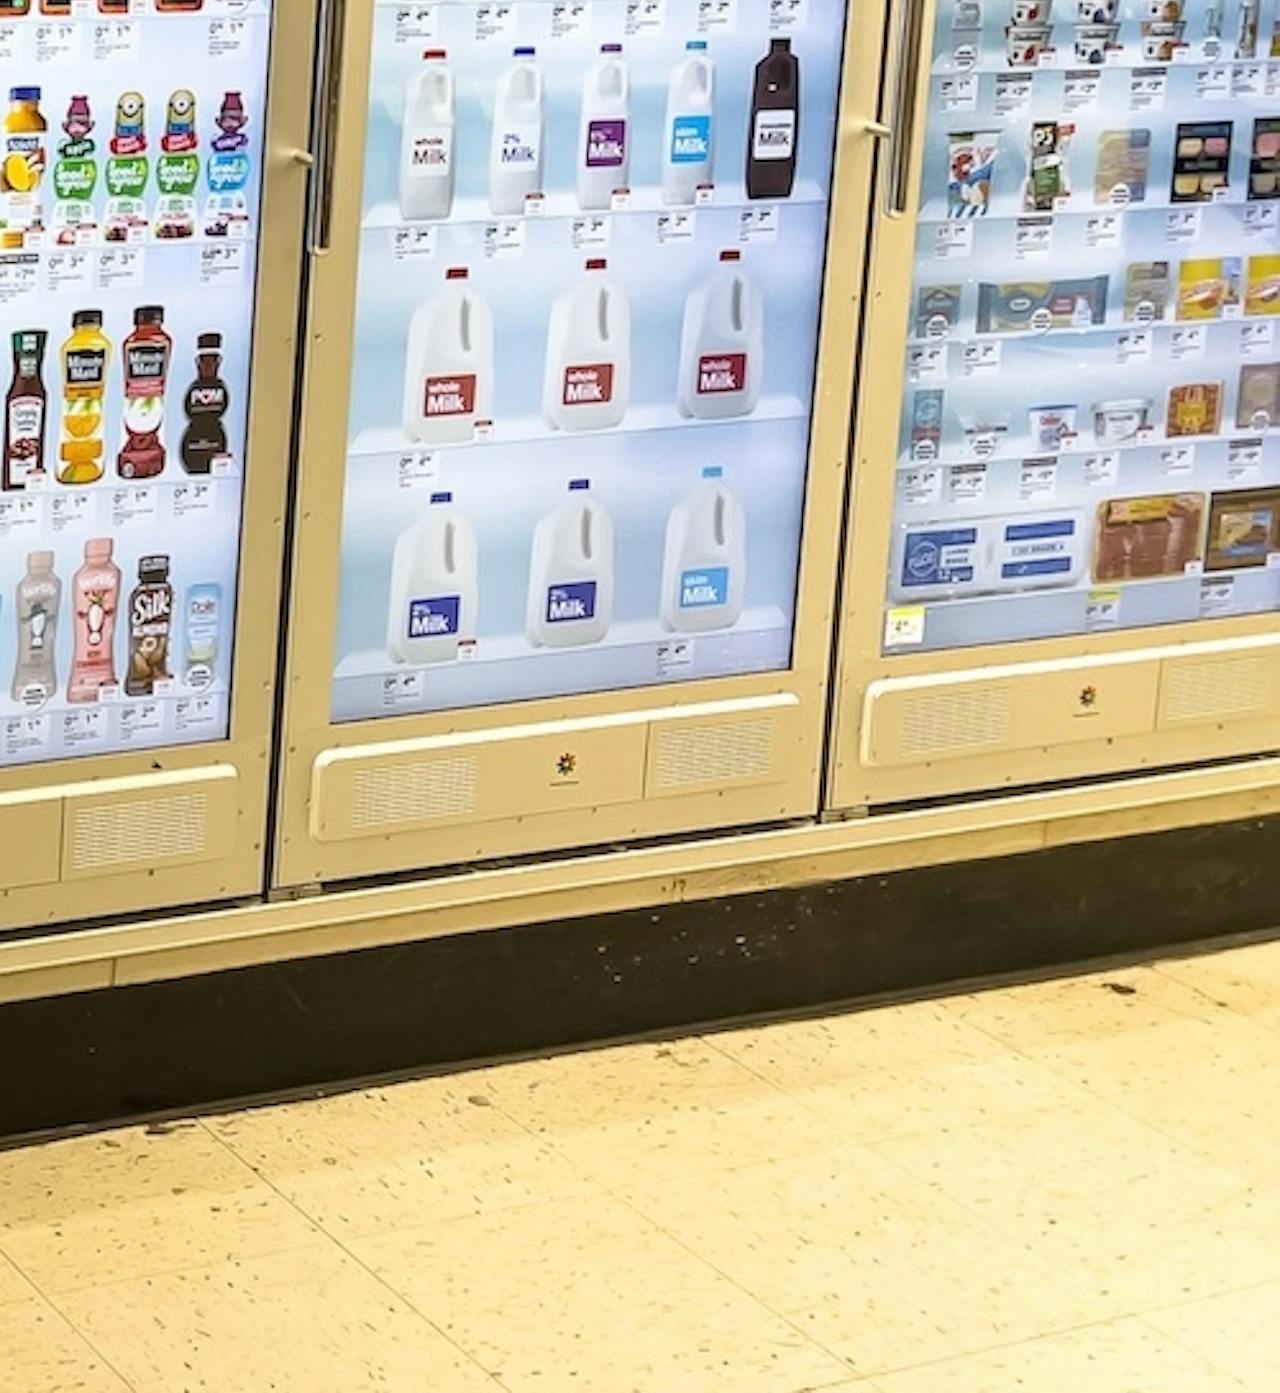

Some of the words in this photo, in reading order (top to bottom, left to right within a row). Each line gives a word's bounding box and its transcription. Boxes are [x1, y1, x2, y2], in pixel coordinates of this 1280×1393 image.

[415, 138, 443, 147] whole
[503, 133, 520, 144] 2%
[674, 138, 707, 156] Milk
[759, 130, 790, 147] Milk
[413, 148, 447, 166] Milk
[501, 144, 535, 164] Milk
[589, 142, 623, 159] Milk
[701, 360, 732, 372] whole
[568, 370, 598, 382] whole
[700, 371, 737, 392] Milk
[429, 382, 460, 394] whole
[566, 382, 603, 402] Milk
[428, 393, 465, 414] Milk
[683, 585, 718, 604] Milk
[134, 591, 170, 625] Silk
[549, 599, 586, 620] Milk
[411, 613, 449, 635] Milk
